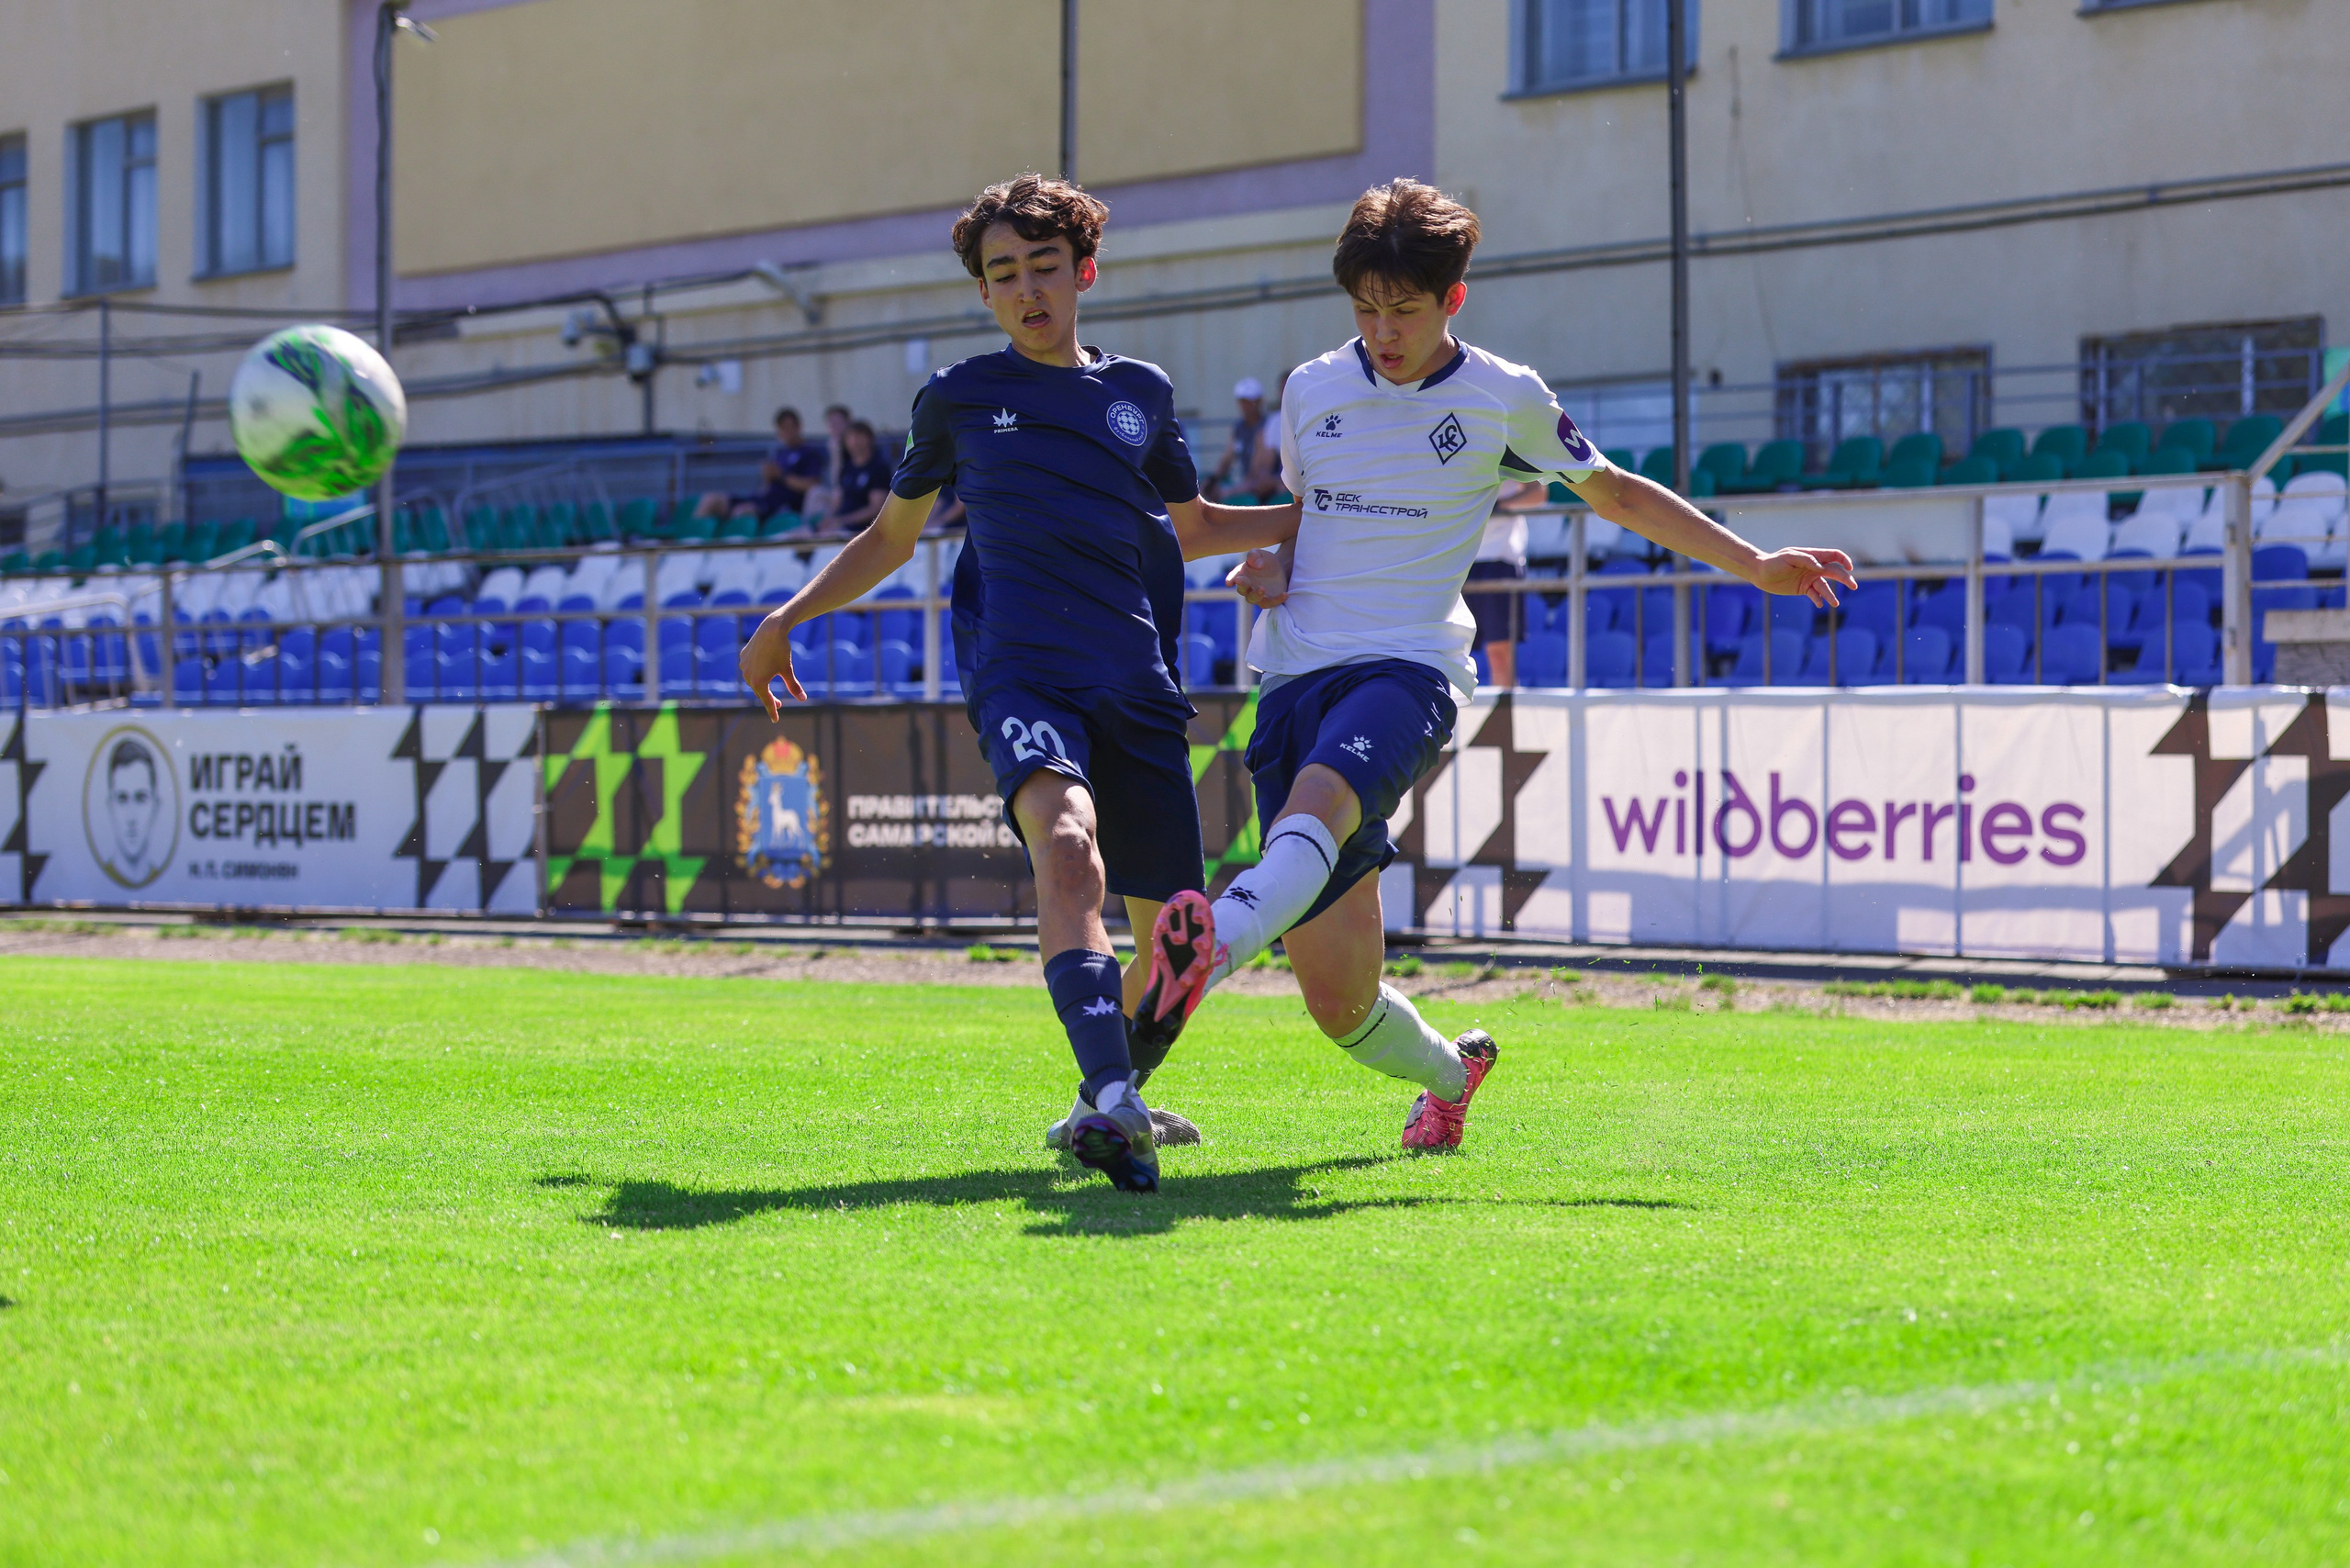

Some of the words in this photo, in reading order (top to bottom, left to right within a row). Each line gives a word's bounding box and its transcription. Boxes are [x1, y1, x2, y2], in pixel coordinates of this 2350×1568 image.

[1110, 404, 1145, 424] ОРЕНБУРГ
[1336, 493, 1361, 503] ДСК
[1336, 502, 1428, 519] ТРАНССТРОЙ
[1001, 716, 1070, 765] 20
[1339, 743, 1370, 763] KELME
[189, 743, 303, 792] ИГРАЙ
[189, 801, 355, 849] СЕРДЦЕМ
[1601, 769, 2087, 867] wildberries
[846, 819, 996, 848] САМАРСКОЙ
